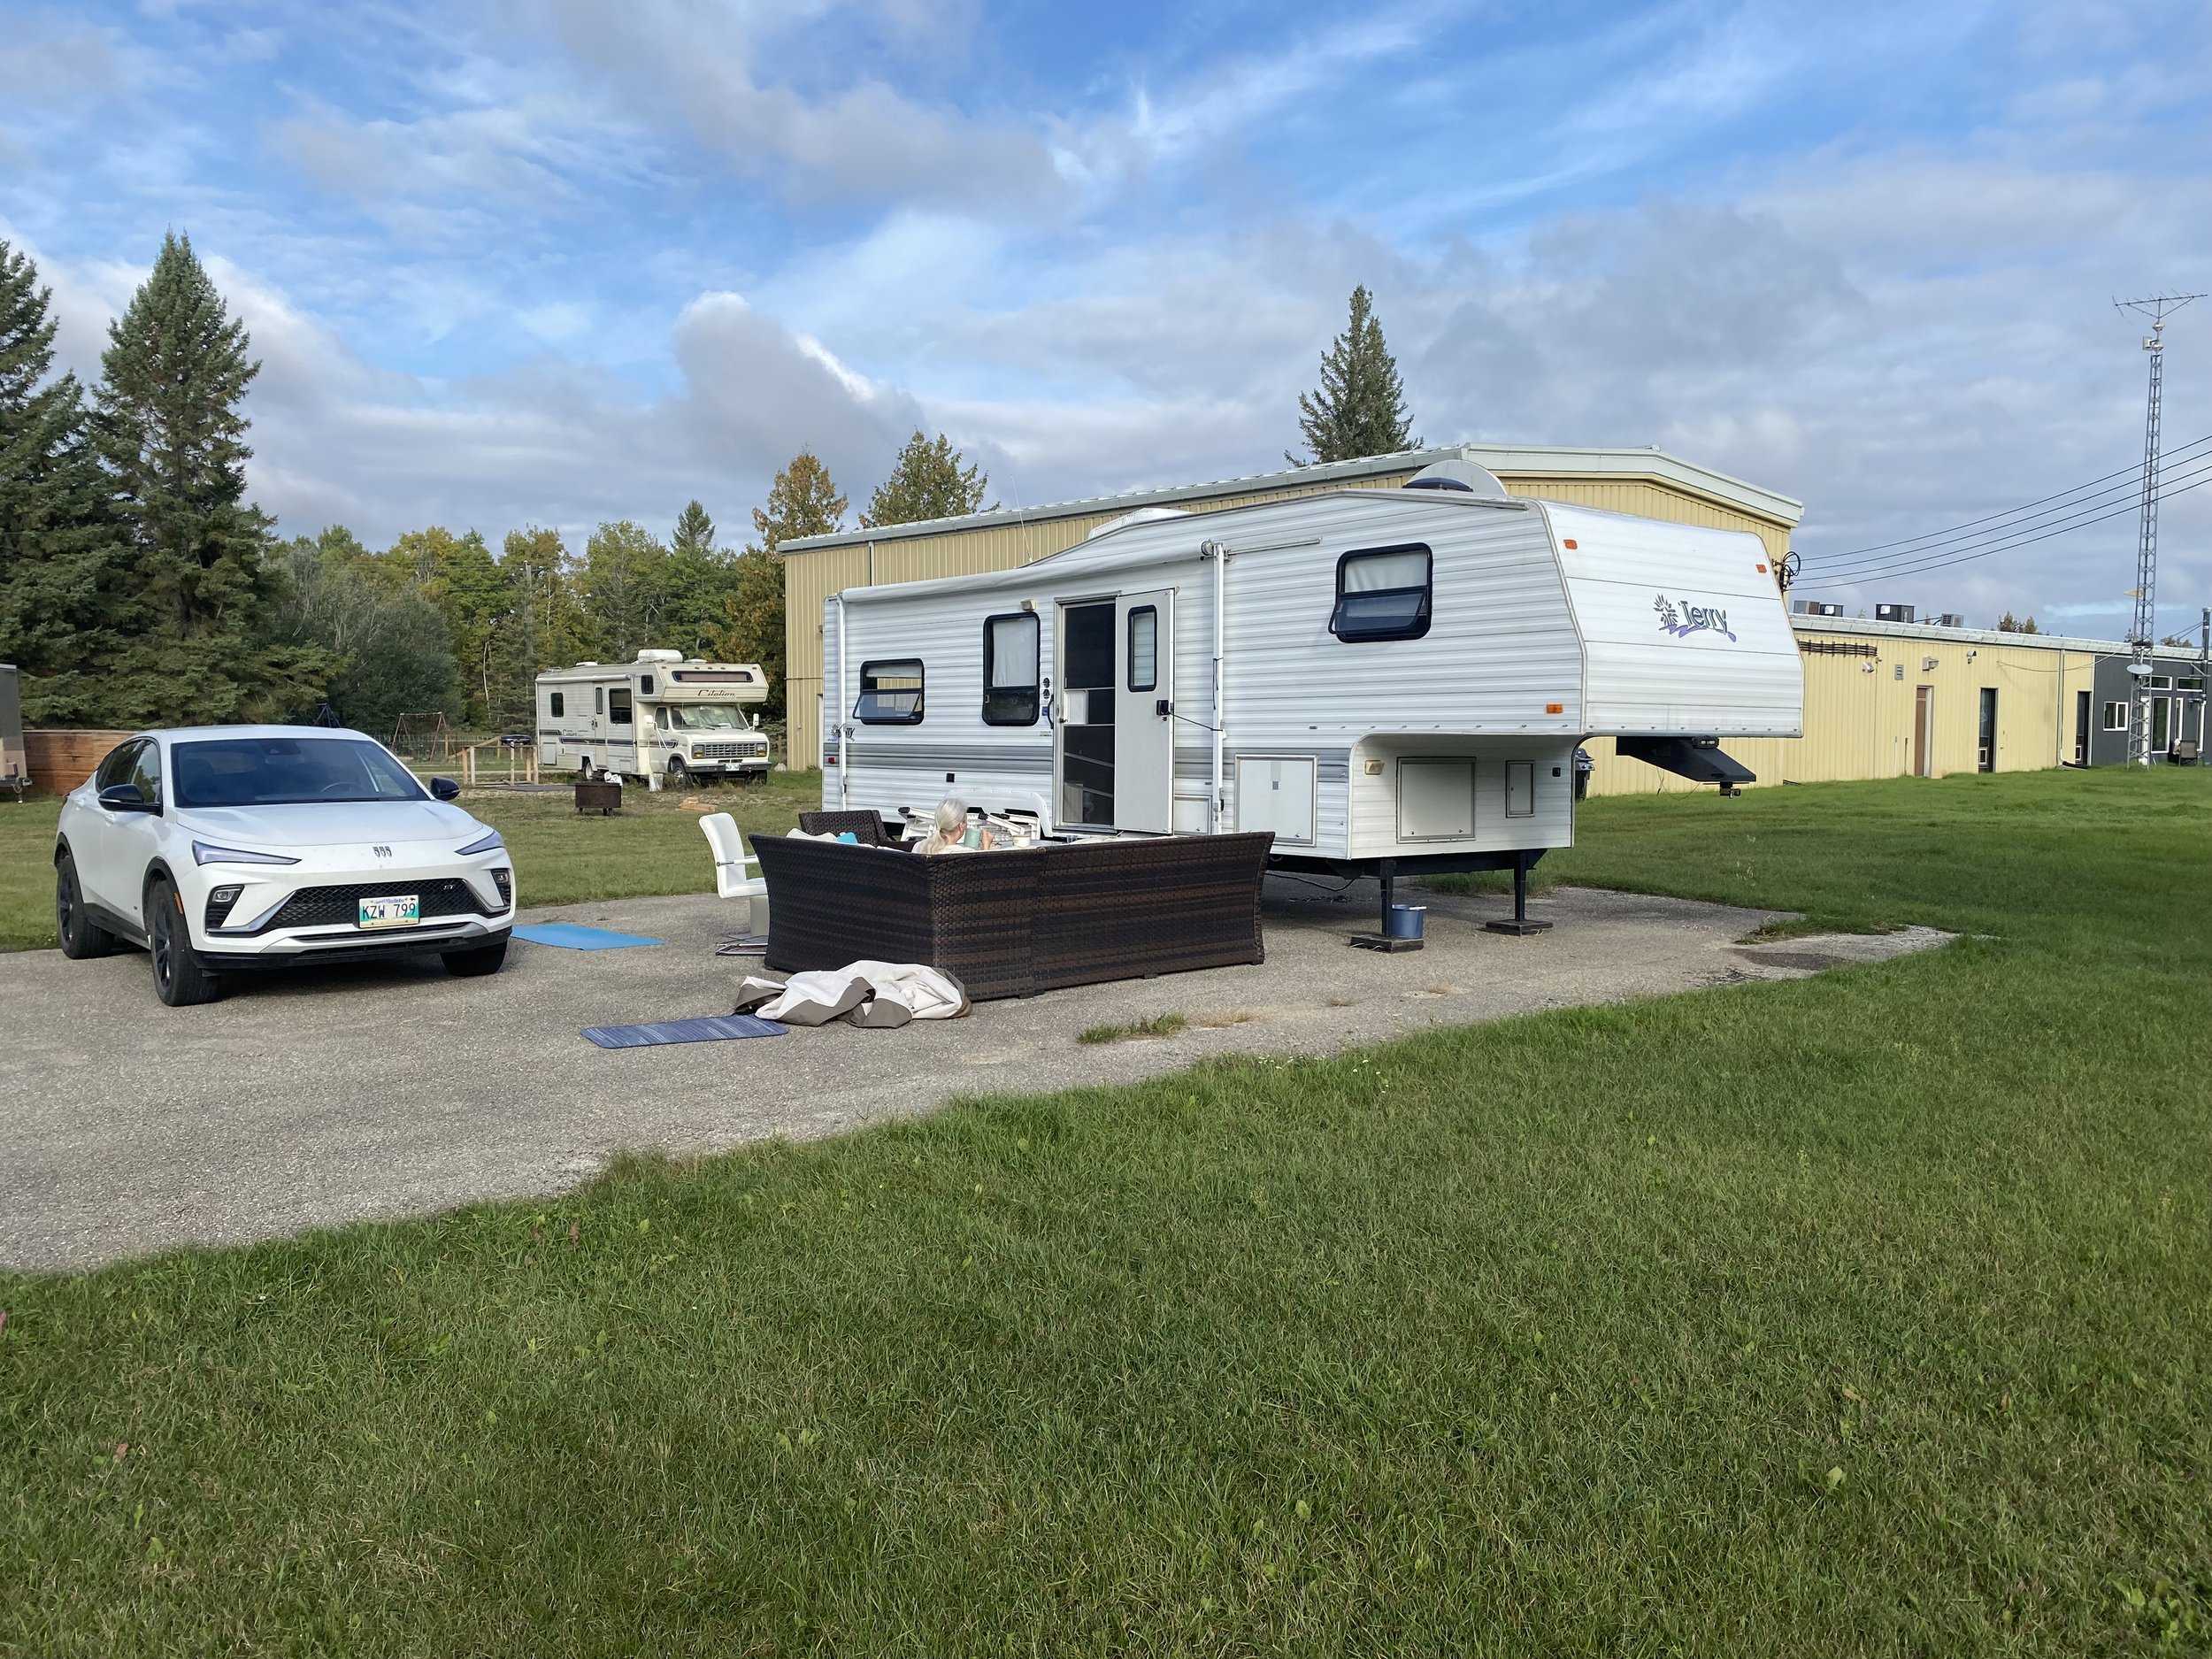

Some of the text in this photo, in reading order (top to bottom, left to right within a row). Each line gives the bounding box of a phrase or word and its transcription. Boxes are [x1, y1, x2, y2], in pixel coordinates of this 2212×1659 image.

[1678, 600, 1727, 634] Terry
[362, 902, 416, 919] KZW 799
